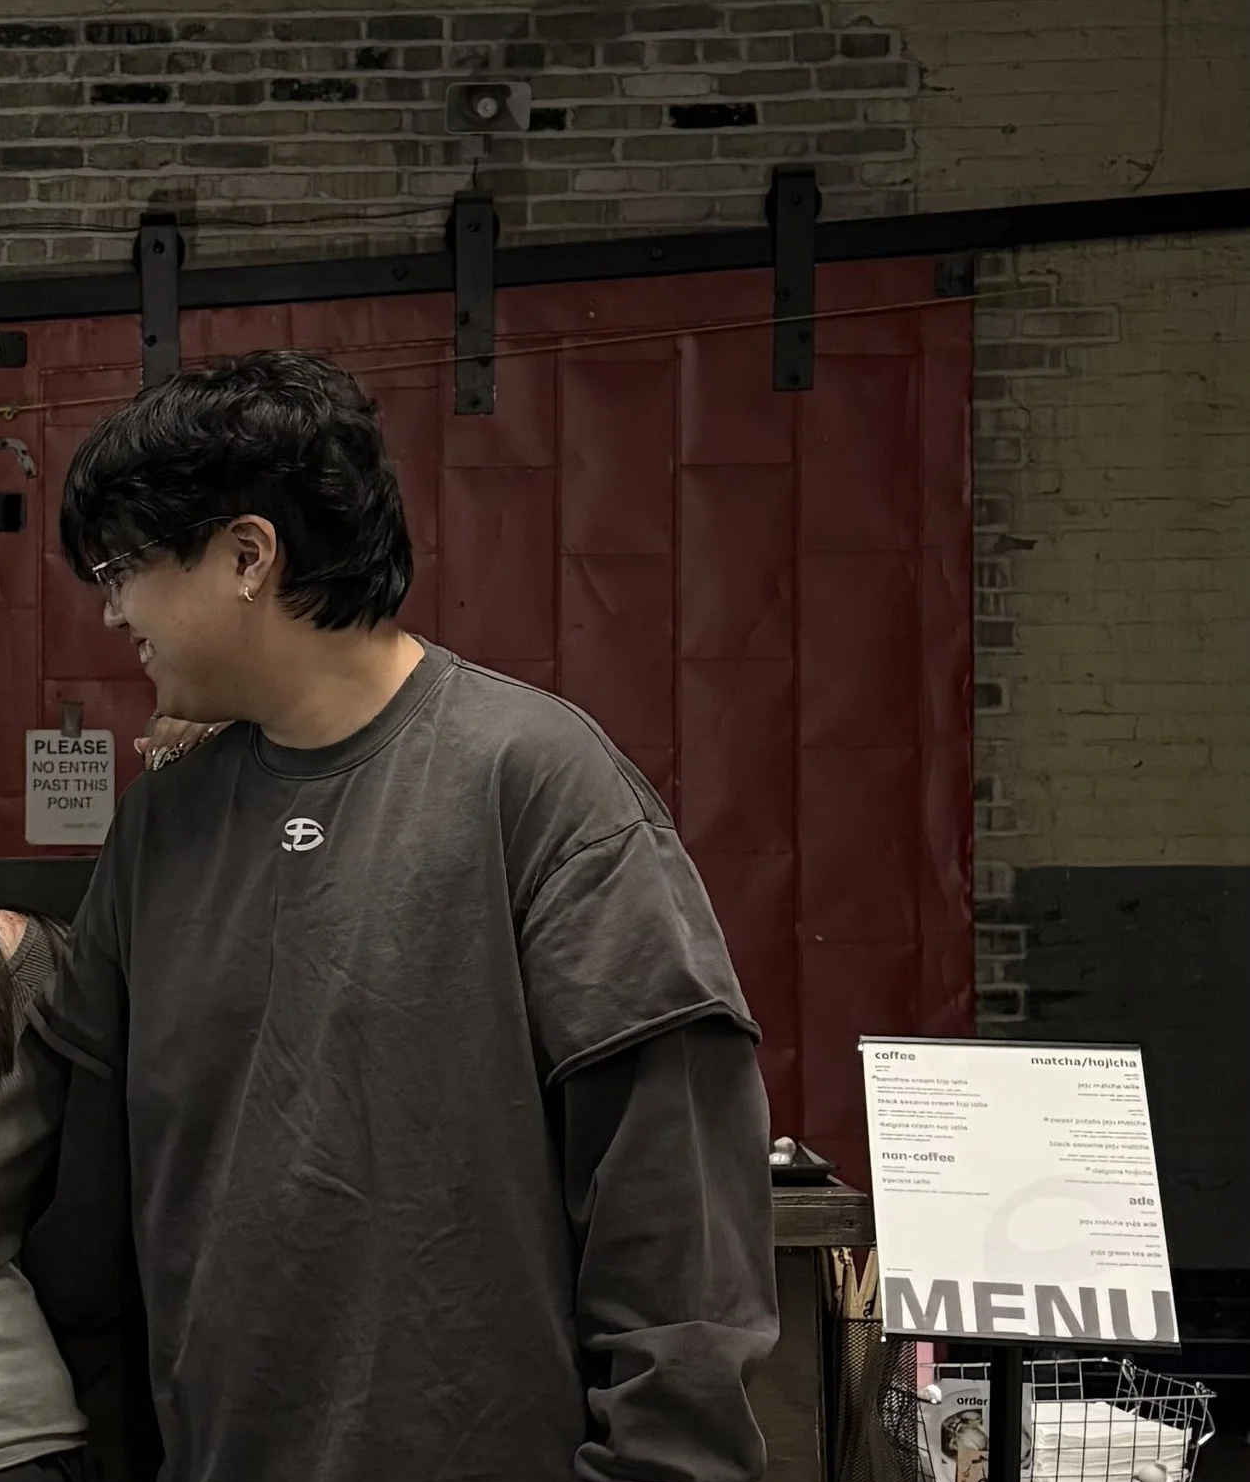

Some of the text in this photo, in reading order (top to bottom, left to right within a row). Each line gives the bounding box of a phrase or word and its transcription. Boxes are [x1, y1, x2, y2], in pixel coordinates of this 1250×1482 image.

[34, 739, 108, 755] PLEASE
[32, 760, 109, 774] NO ENTRY
[33, 778, 108, 792] PAST THIS
[47, 796, 93, 810] POINT
[874, 1050, 916, 1061] coffee
[1030, 1056, 1138, 1069] matcha/hojicha
[881, 1150, 956, 1163] non-coffee
[1129, 1196, 1155, 1207] ade
[884, 1276, 1175, 1343] MENU
